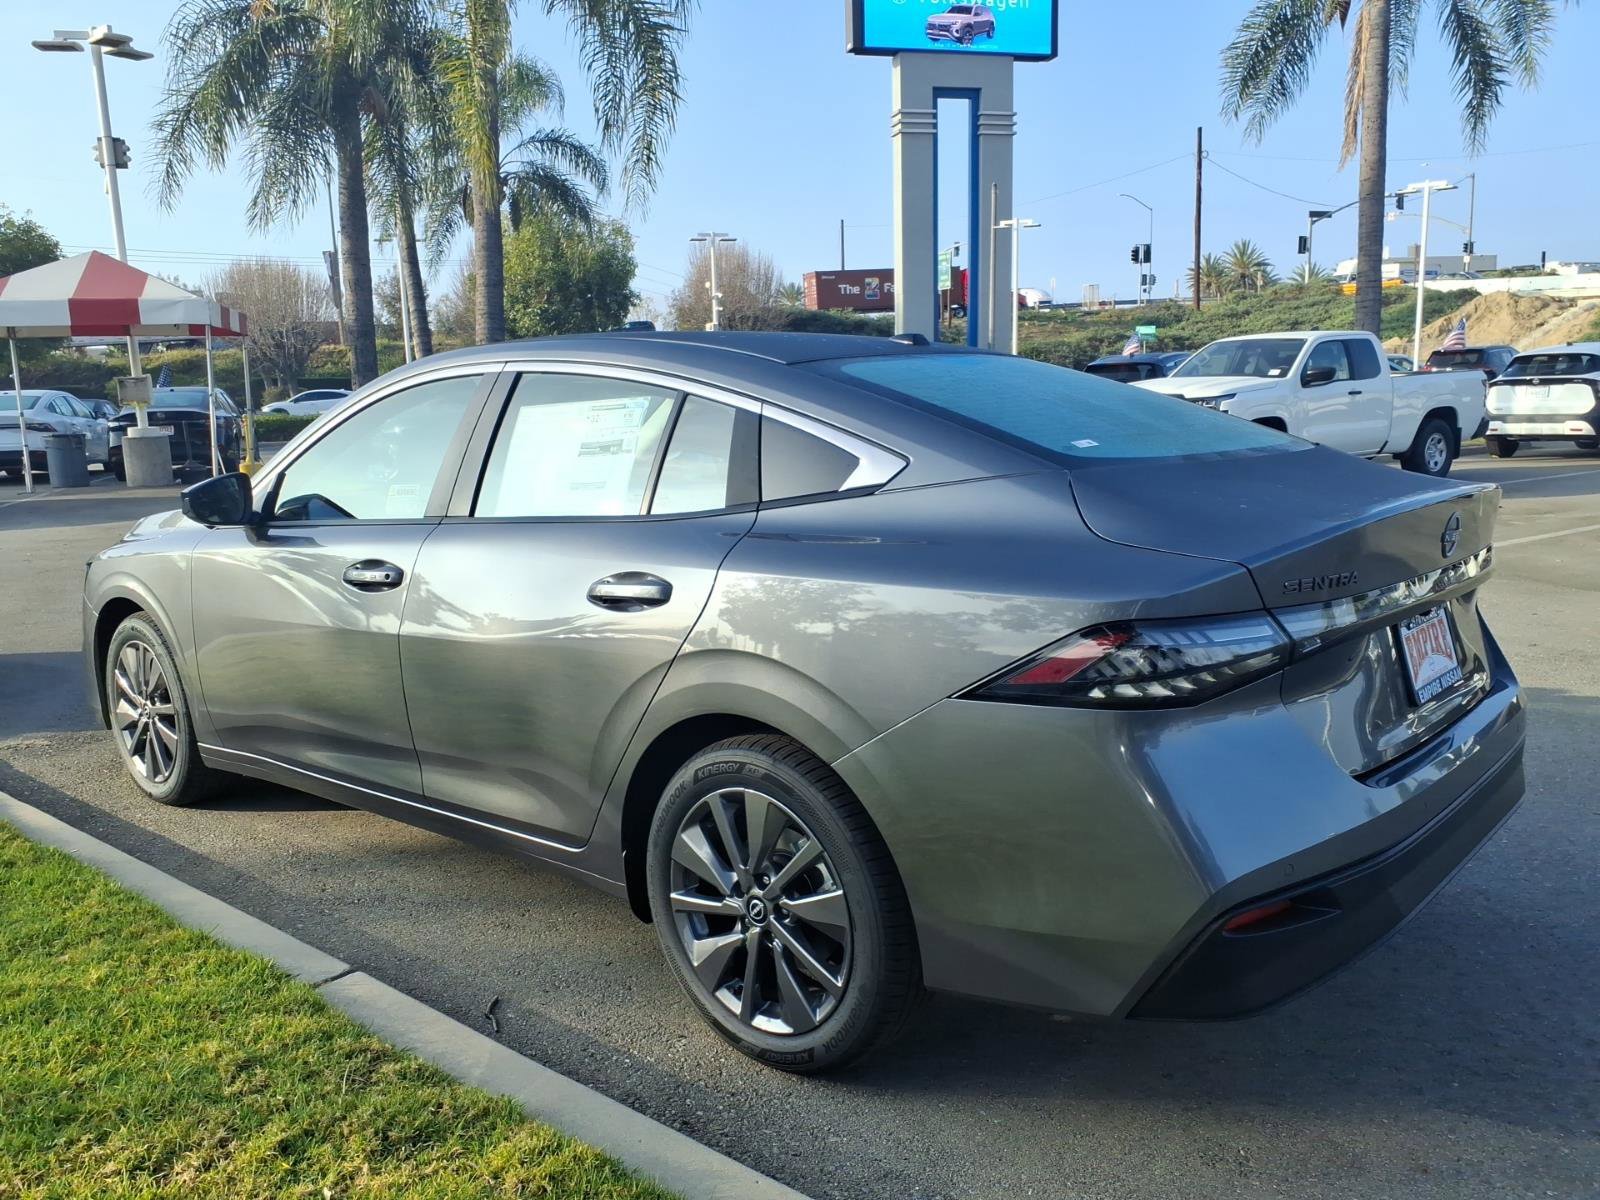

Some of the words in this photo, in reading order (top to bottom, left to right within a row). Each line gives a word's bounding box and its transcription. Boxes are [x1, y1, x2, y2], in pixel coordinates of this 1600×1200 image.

[838, 284, 861, 295] The
[1282, 570, 1358, 594] SENTRA
[1404, 618, 1454, 684] EMPIRE
[1418, 680, 1442, 703] EMPIRE
[1440, 666, 1463, 689] NISSAN
